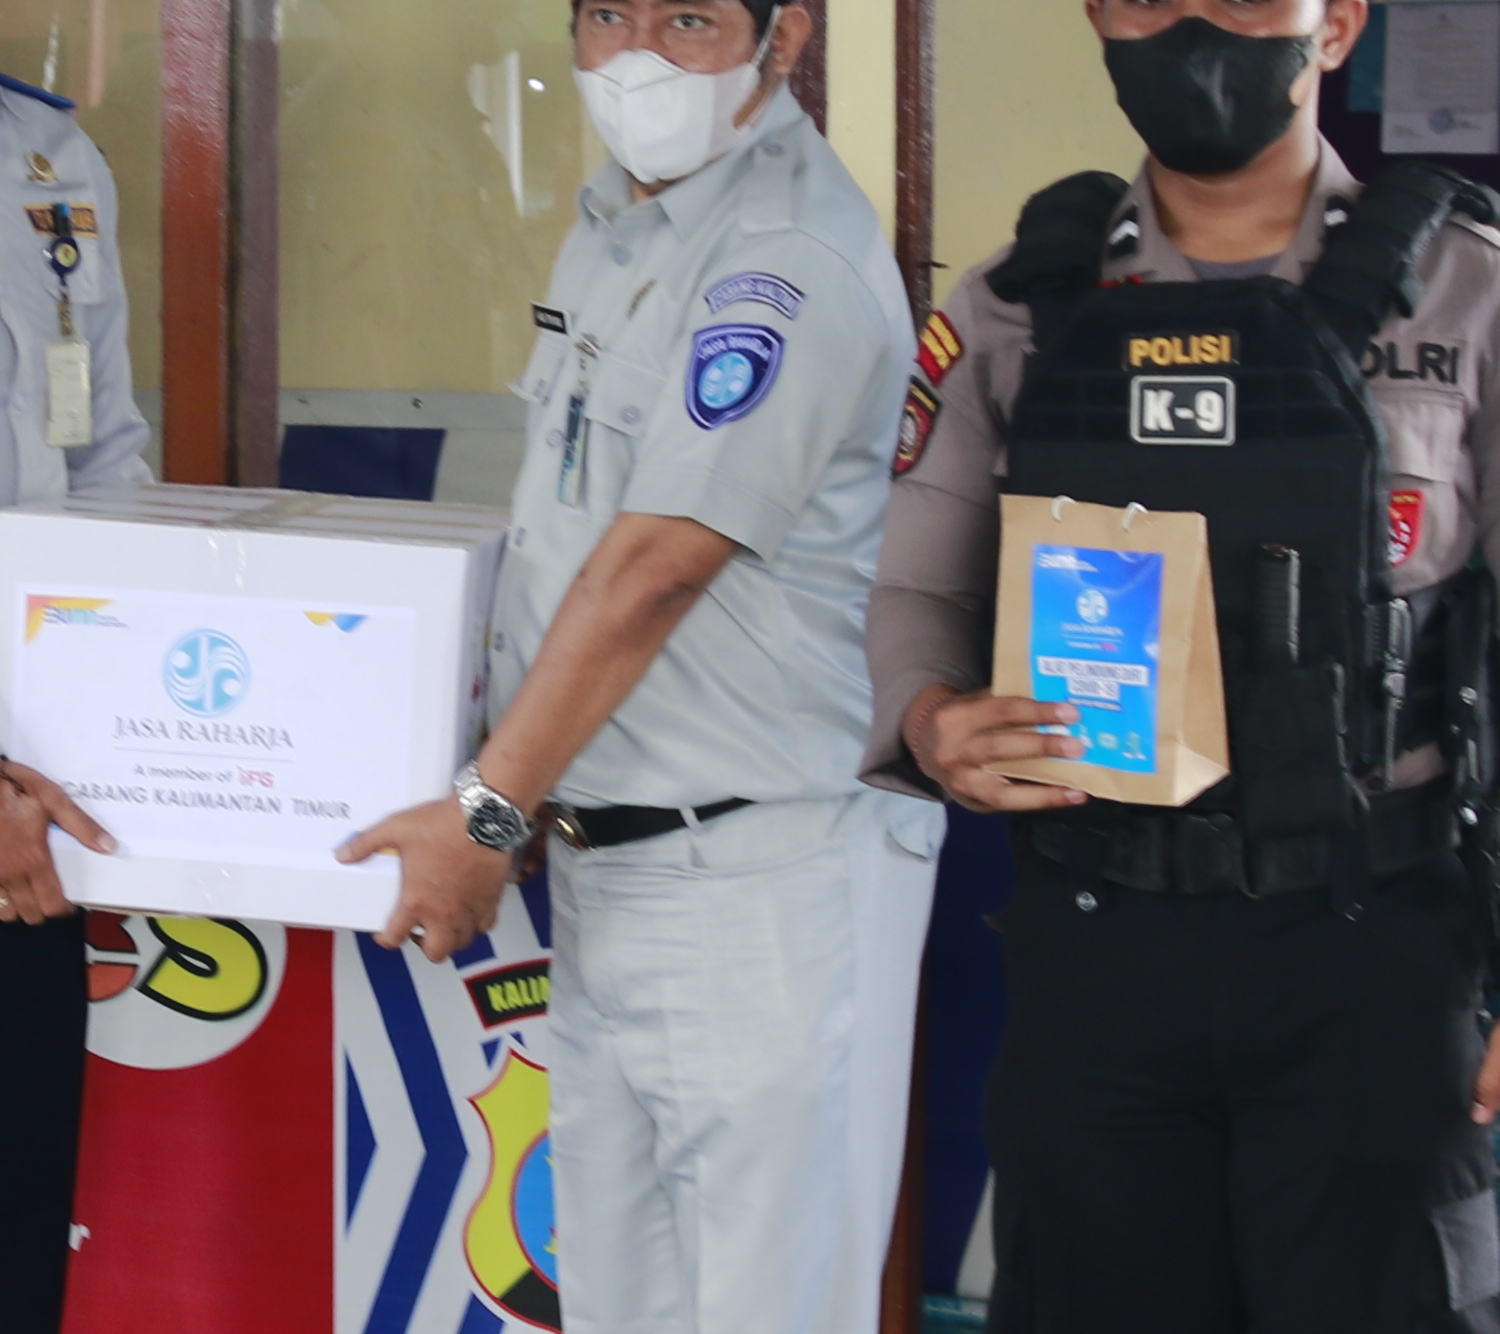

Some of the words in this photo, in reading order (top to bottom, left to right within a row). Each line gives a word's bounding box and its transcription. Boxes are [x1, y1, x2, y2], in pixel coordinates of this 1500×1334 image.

[1128, 335, 1233, 366] POLISI
[1362, 341, 1460, 384] OLRI
[1142, 389, 1225, 433] K-9
[111, 715, 171, 740] JASA
[175, 719, 295, 751] RAHARJA
[148, 765, 212, 783] member
[62, 779, 148, 805] CABANG
[152, 788, 282, 815] KALIMANTAN
[290, 797, 352, 820] TIMUR
